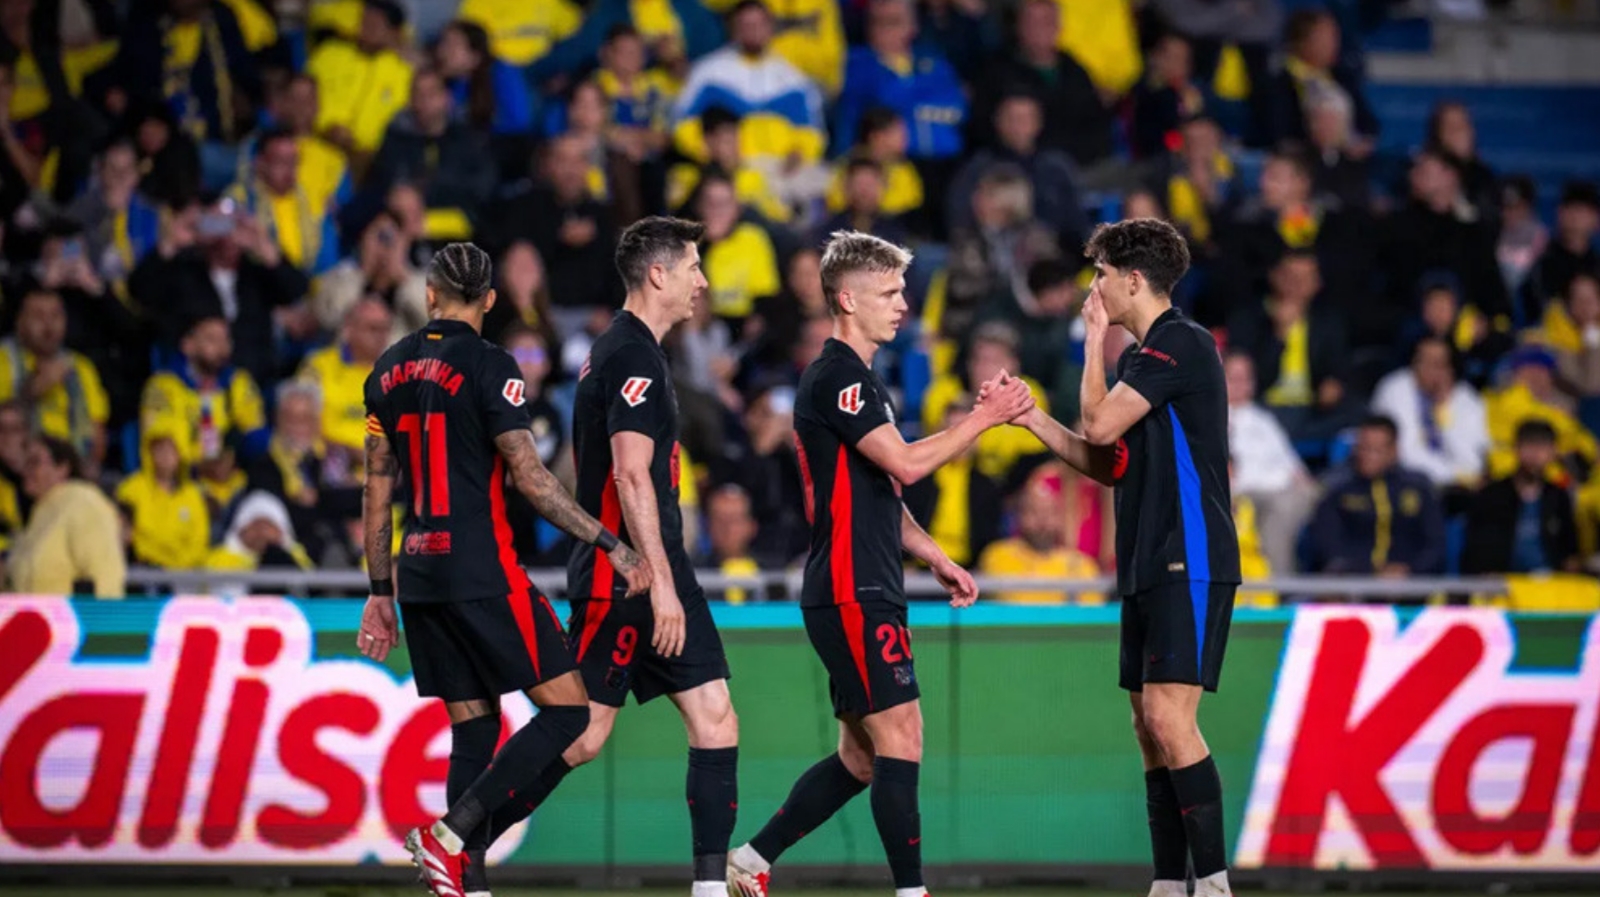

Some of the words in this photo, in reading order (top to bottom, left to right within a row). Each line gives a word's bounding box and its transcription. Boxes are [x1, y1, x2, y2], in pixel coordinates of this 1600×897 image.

[380, 358, 464, 396] RAPHINHA
[396, 412, 449, 517] 11
[612, 625, 638, 666] 9
[0, 611, 513, 850] alise
